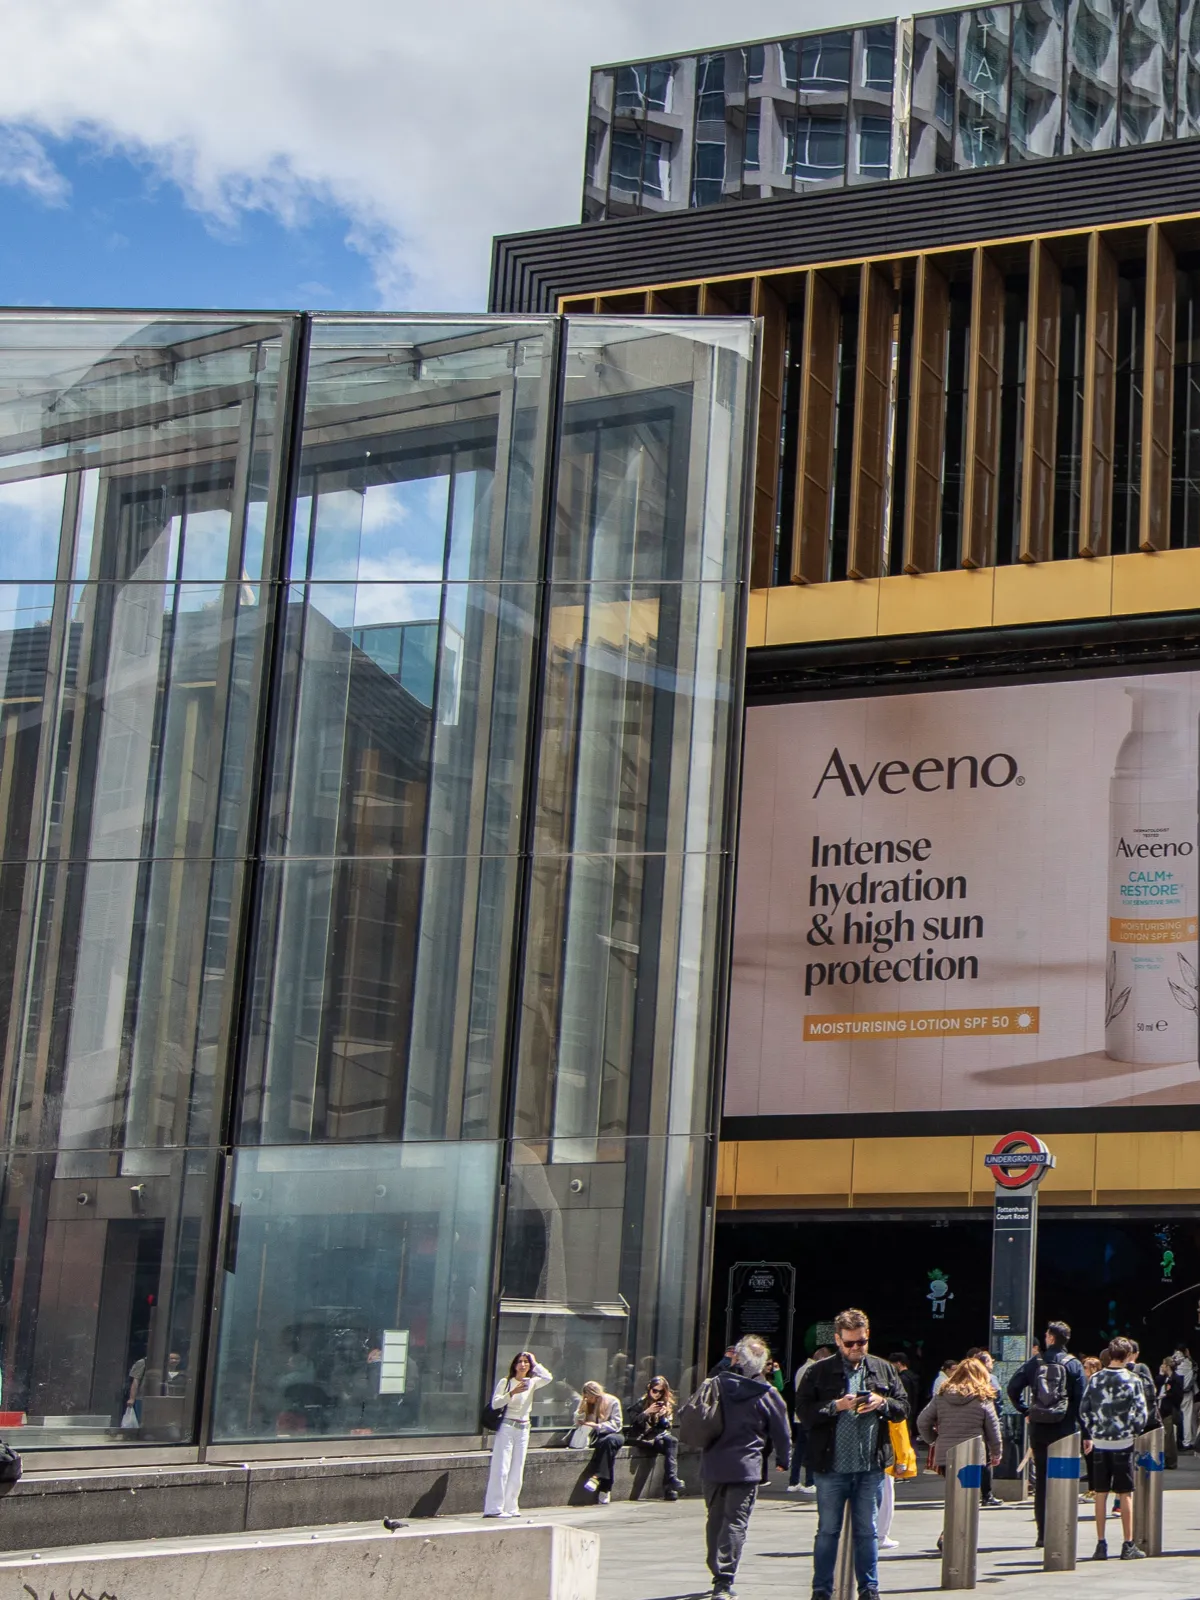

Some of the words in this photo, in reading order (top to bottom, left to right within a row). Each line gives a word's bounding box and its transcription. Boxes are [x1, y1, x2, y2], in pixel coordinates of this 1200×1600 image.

[811, 835, 932, 868] Intense
[1115, 836, 1194, 859] Aveeno
[1128, 871, 1174, 883] CALM+
[809, 868, 968, 915] hydration
[806, 913, 836, 947] &
[843, 910, 915, 954] high
[922, 914, 985, 941] sun
[1120, 921, 1181, 931] MOISTURISING
[1120, 932, 1149, 941] LOTION
[1151, 932, 1169, 941] SPF
[1171, 931, 1181, 940] 50
[804, 948, 979, 996] protection
[810, 1020, 907, 1035] MOISTURISING
[909, 1017, 961, 1032] LOTION
[963, 1016, 988, 1029] SPF
[991, 1015, 1010, 1028] 50
[1136, 1022, 1144, 1032] 50
[1145, 1022, 1153, 1032] ml
[986, 1154, 1045, 1163] UNDERGROUND
